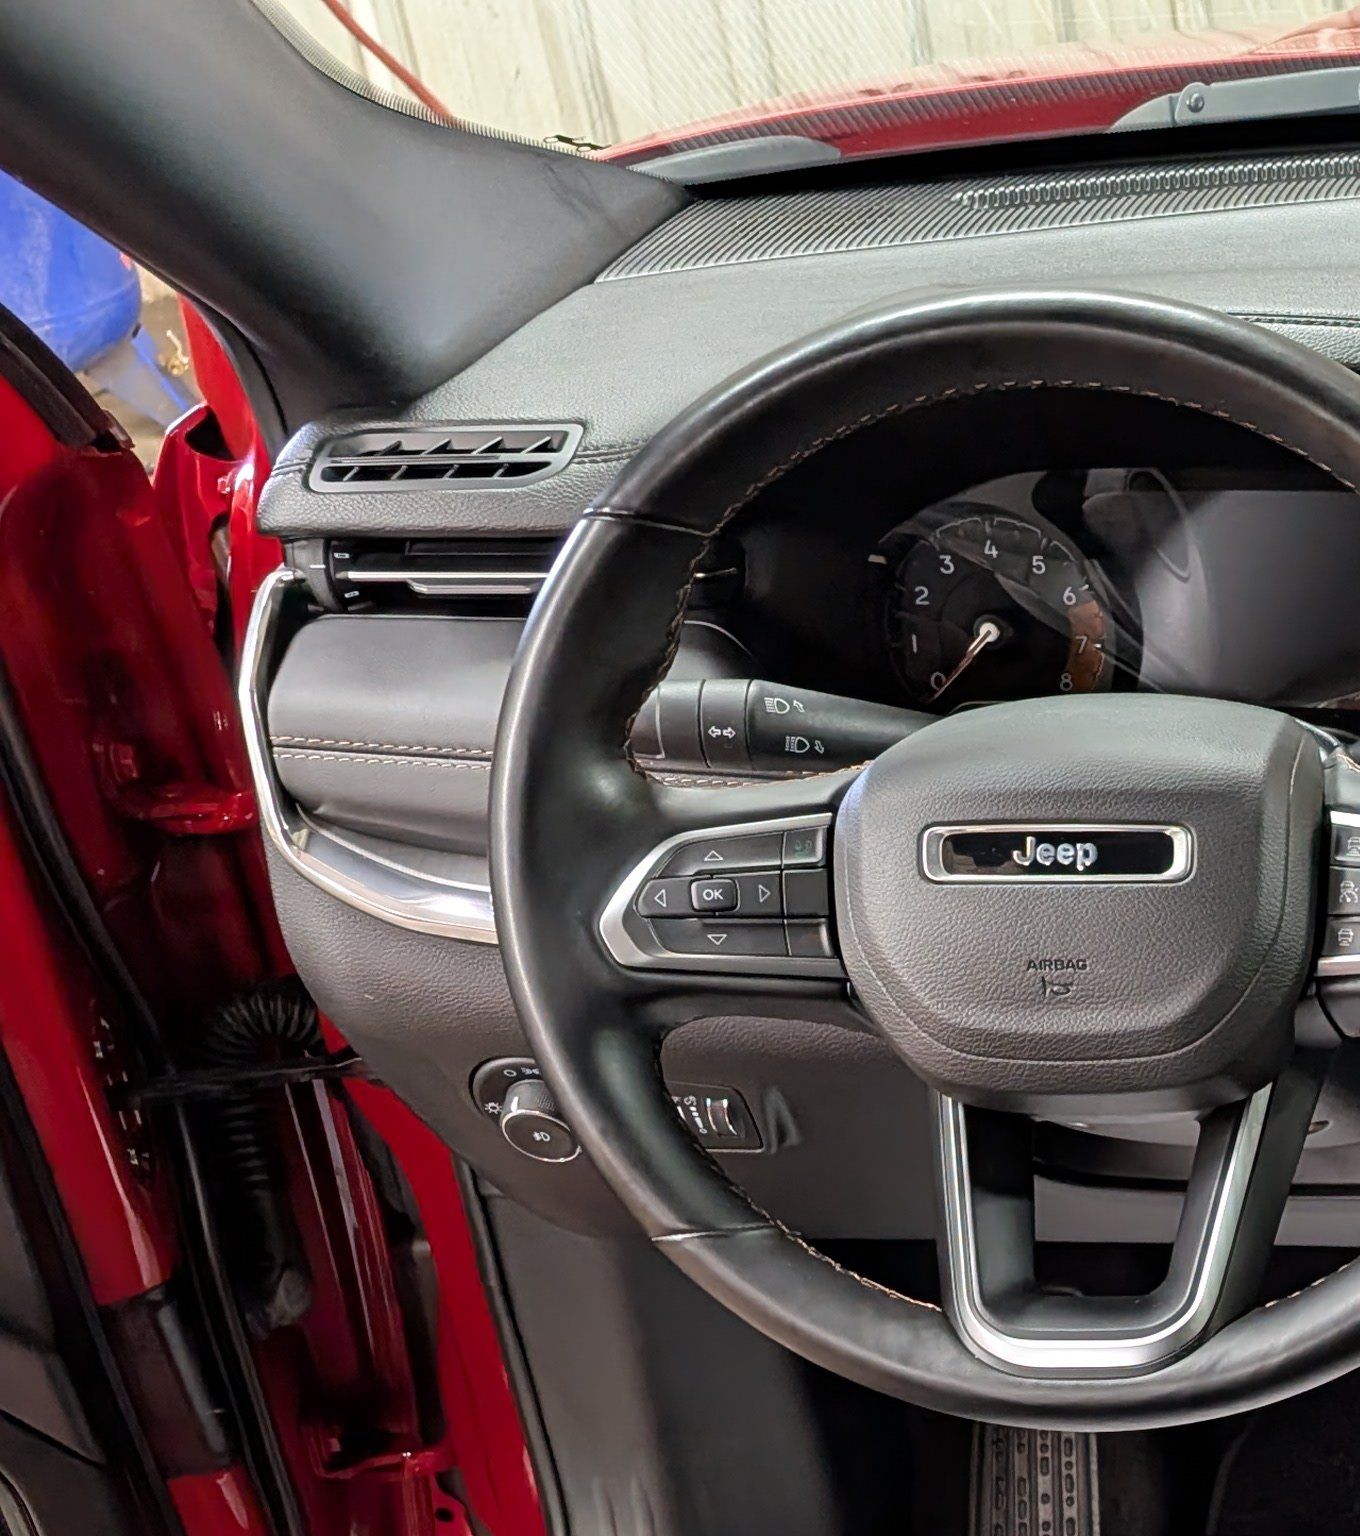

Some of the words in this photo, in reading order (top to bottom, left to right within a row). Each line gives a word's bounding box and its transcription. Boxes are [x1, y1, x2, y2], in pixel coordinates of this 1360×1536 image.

[984, 540, 999, 558] 4
[939, 555, 955, 575] 3
[1032, 555, 1046, 574] 5
[914, 586, 930, 605] 2
[1062, 587, 1077, 605] 6
[1075, 636, 1088, 654] 7
[1059, 672, 1073, 692] 8
[1012, 836, 1098, 872] Jeep
[702, 889, 724, 901] OK
[1026, 958, 1088, 972] AIRBAG
